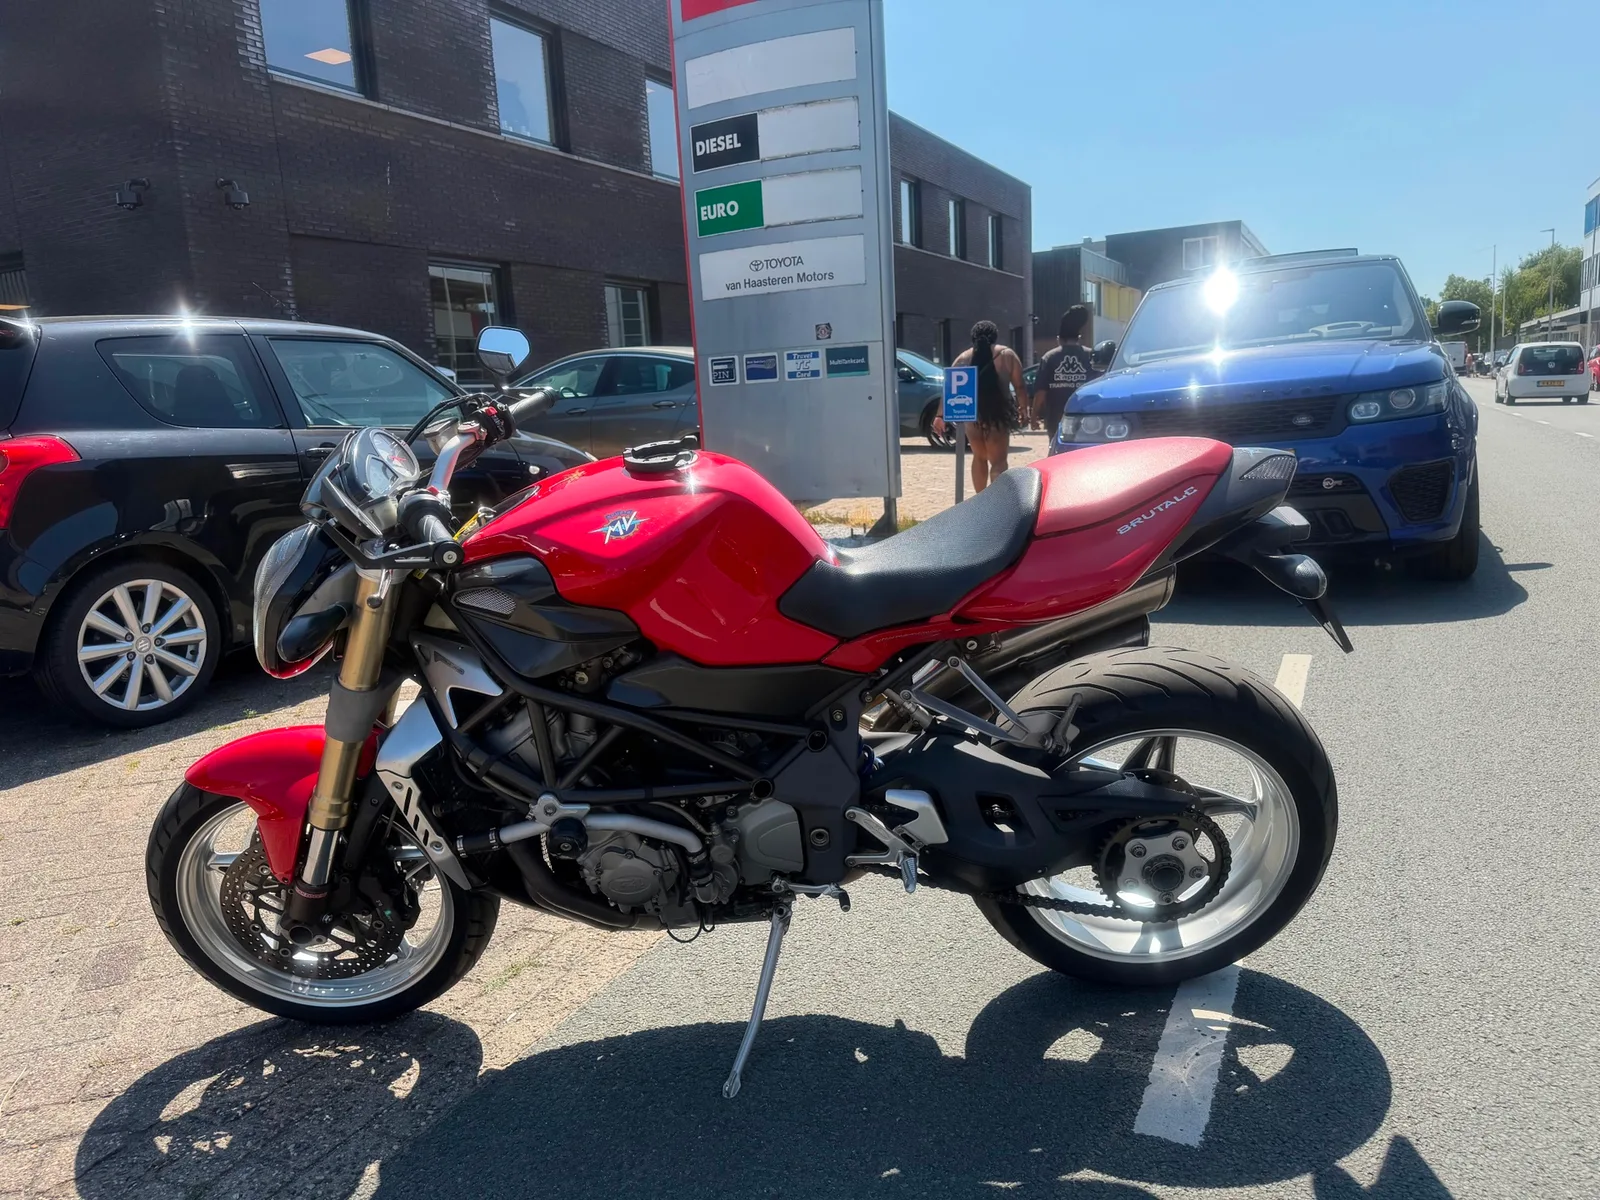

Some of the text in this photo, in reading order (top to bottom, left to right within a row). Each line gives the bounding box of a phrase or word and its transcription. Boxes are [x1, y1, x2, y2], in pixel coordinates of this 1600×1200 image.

[695, 133, 742, 157] DIESEL
[700, 200, 739, 221] EURO
[764, 256, 804, 270] TOYOTA
[725, 271, 835, 291] van Haasteren Motors
[712, 370, 730, 380] PIN
[951, 371, 969, 395] P
[1054, 373, 1087, 382] Kappa
